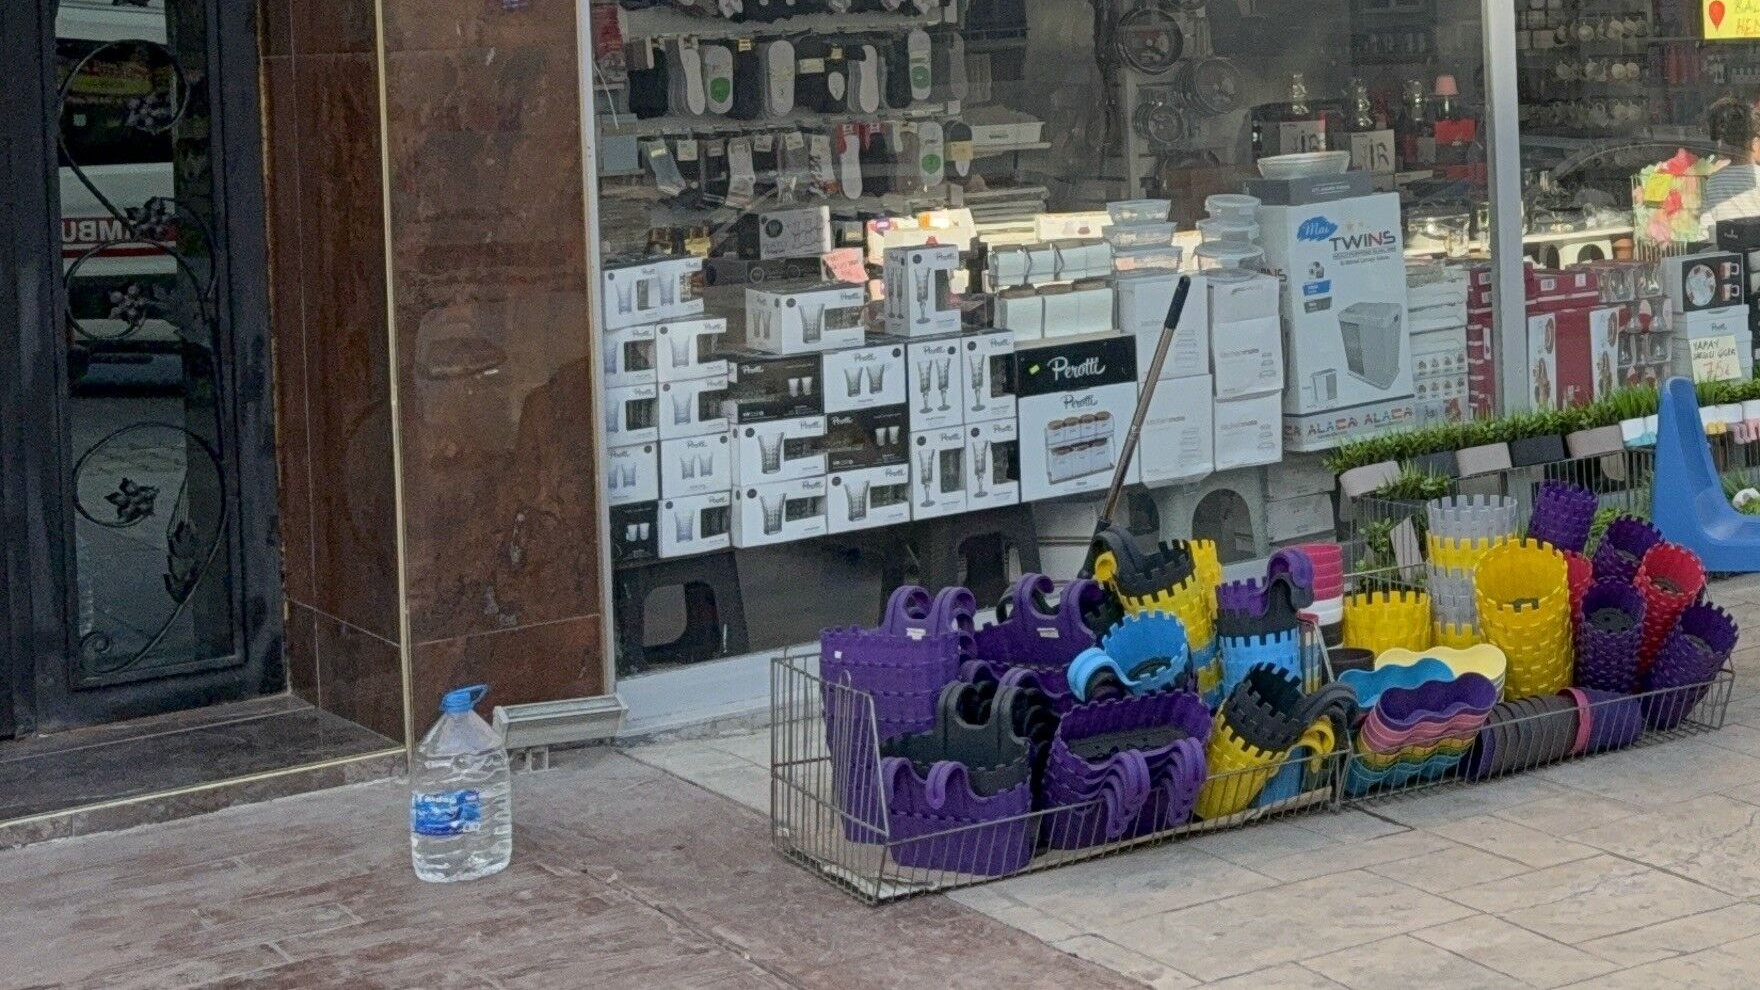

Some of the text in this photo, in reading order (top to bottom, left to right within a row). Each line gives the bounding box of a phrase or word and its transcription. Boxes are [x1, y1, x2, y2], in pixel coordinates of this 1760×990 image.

[1328, 230, 1397, 252] TWINS
[1047, 355, 1106, 381] Perotti
[1060, 394, 1099, 409] Perotti
